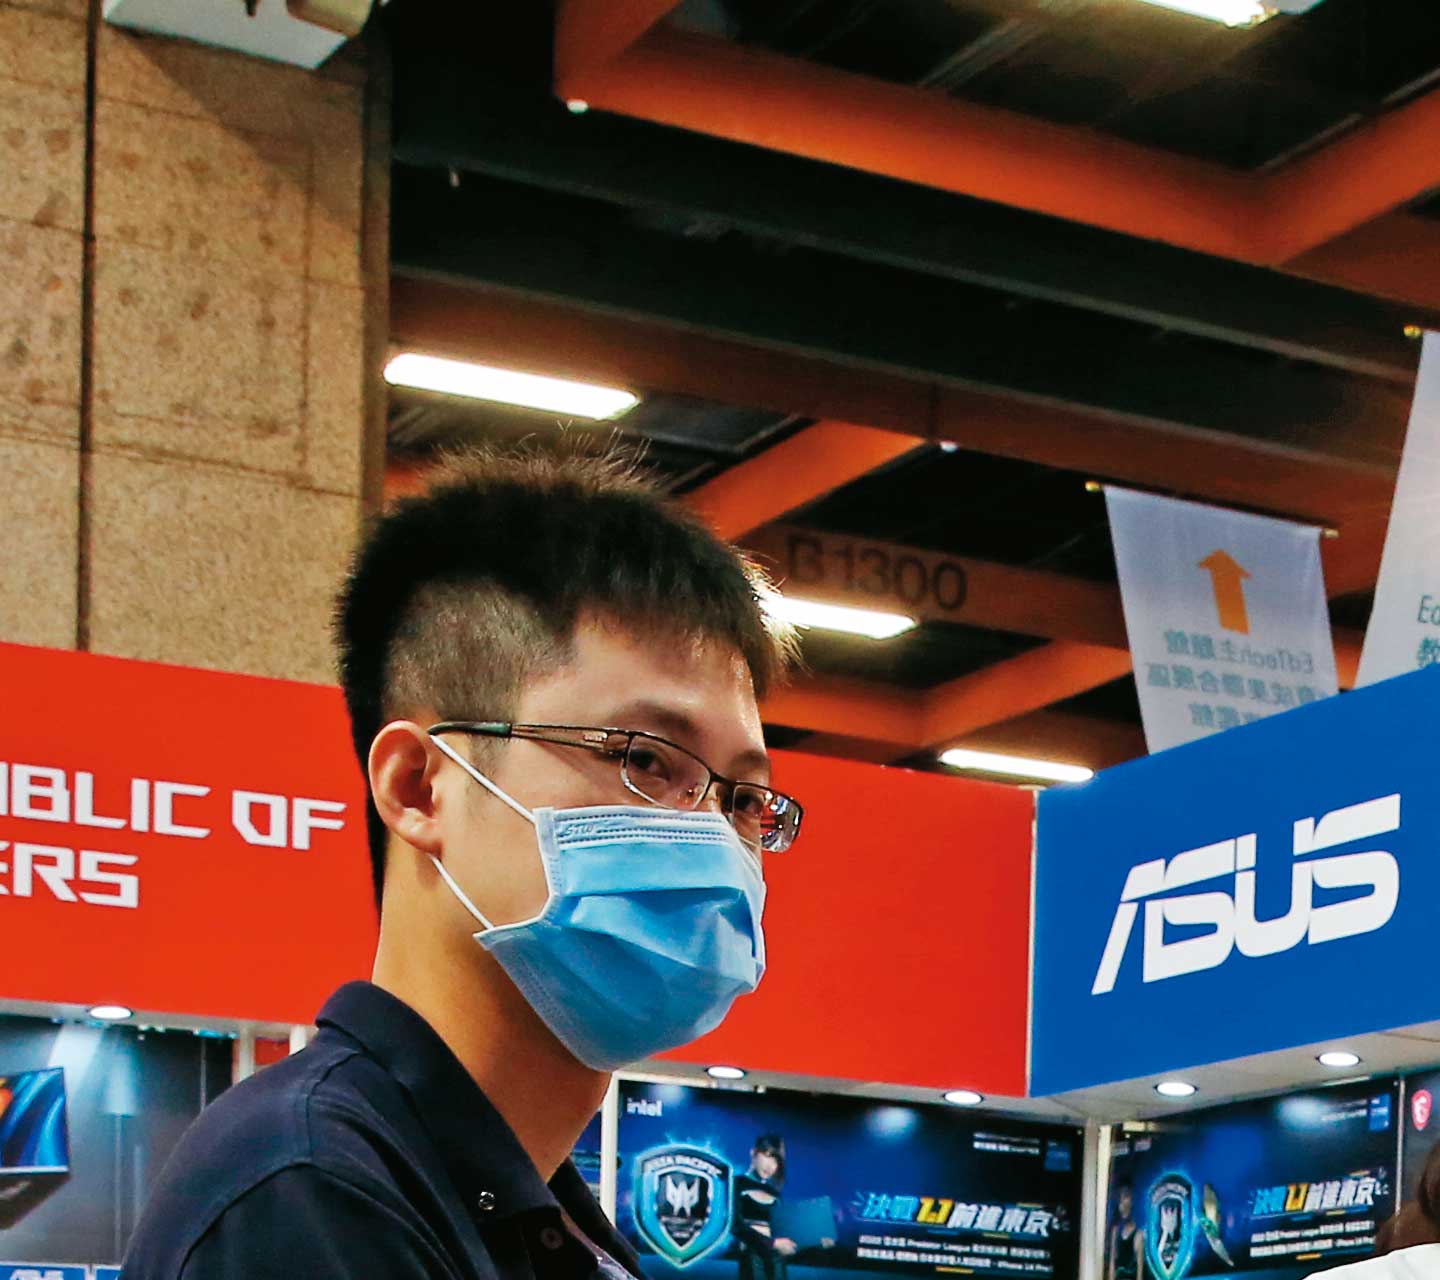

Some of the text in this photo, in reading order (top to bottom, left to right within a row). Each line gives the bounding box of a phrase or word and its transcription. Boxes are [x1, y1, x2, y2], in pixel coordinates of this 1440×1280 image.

[232, 790, 345, 850] OF
[1092, 794, 1399, 995] ASUS
[627, 1098, 662, 1117] intel
